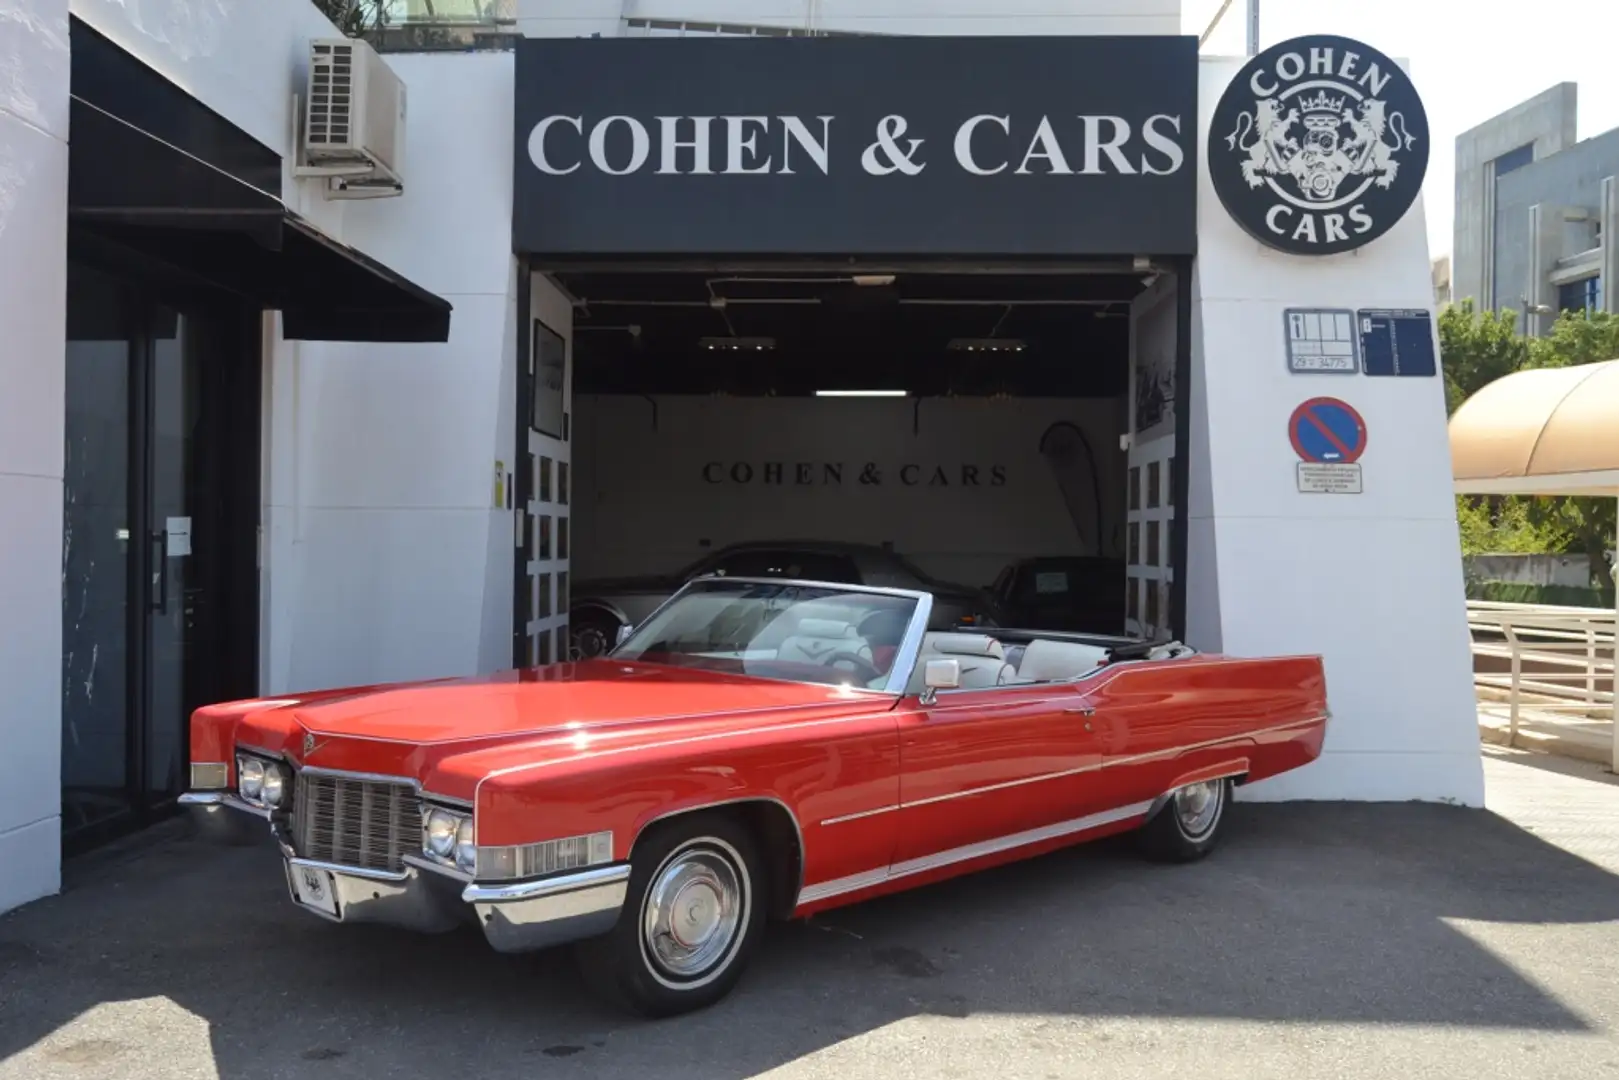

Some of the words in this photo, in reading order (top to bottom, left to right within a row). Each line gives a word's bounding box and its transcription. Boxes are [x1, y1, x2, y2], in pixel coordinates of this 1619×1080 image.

[1250, 47, 1392, 97] COHEN
[527, 114, 836, 175] COHEN
[861, 114, 926, 176] &
[953, 114, 1184, 176] CARS
[1265, 203, 1373, 243] CARS
[702, 461, 843, 485] COHEN
[858, 461, 881, 486] &
[900, 463, 1007, 486] CARS
